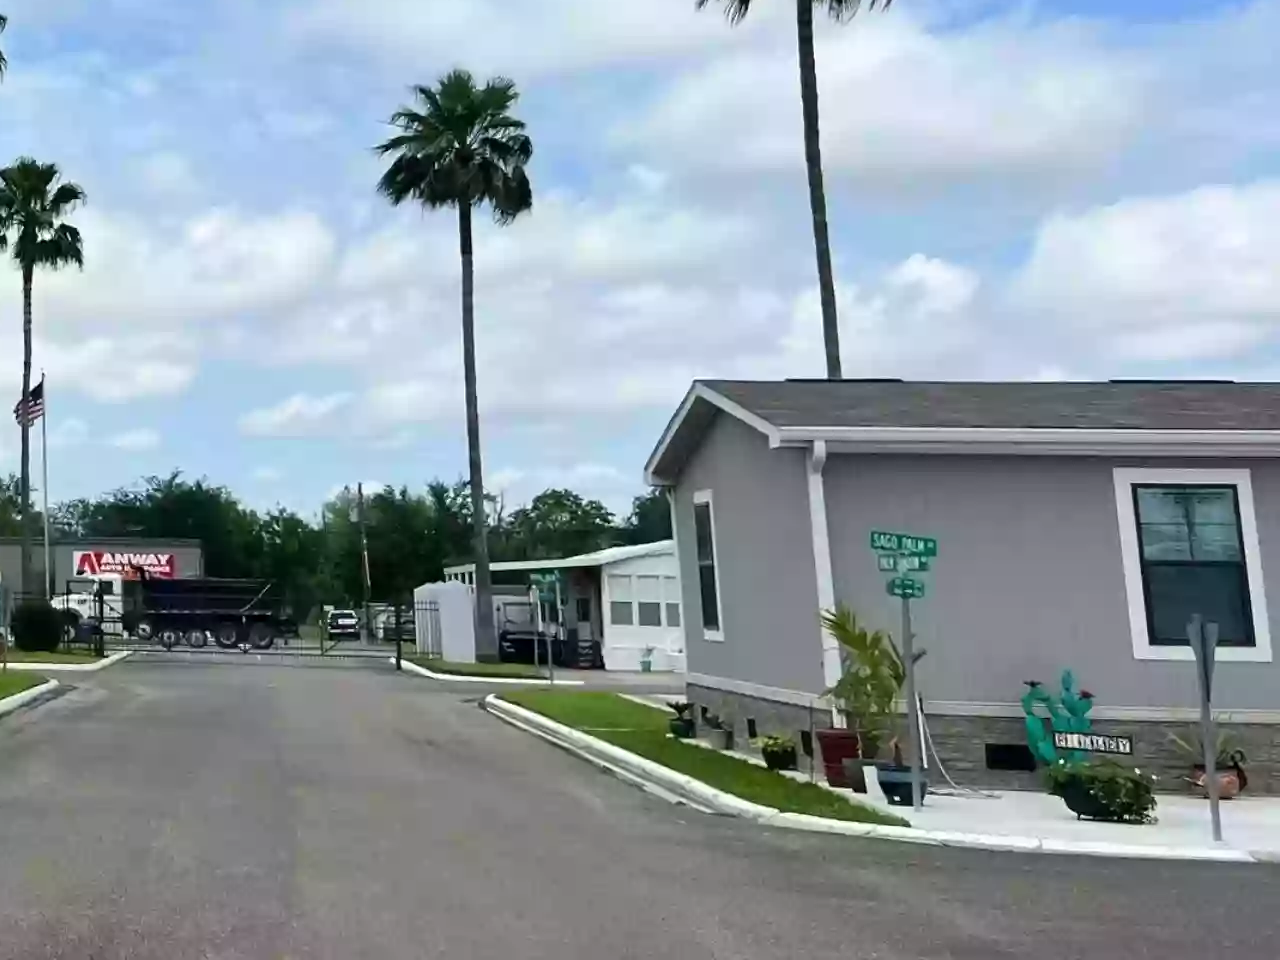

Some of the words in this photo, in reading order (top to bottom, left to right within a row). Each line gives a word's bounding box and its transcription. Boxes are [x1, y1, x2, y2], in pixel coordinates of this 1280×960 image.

[873, 533, 897, 549] SAGO
[902, 537, 924, 552] PALM
[101, 553, 170, 565] ANWAY
